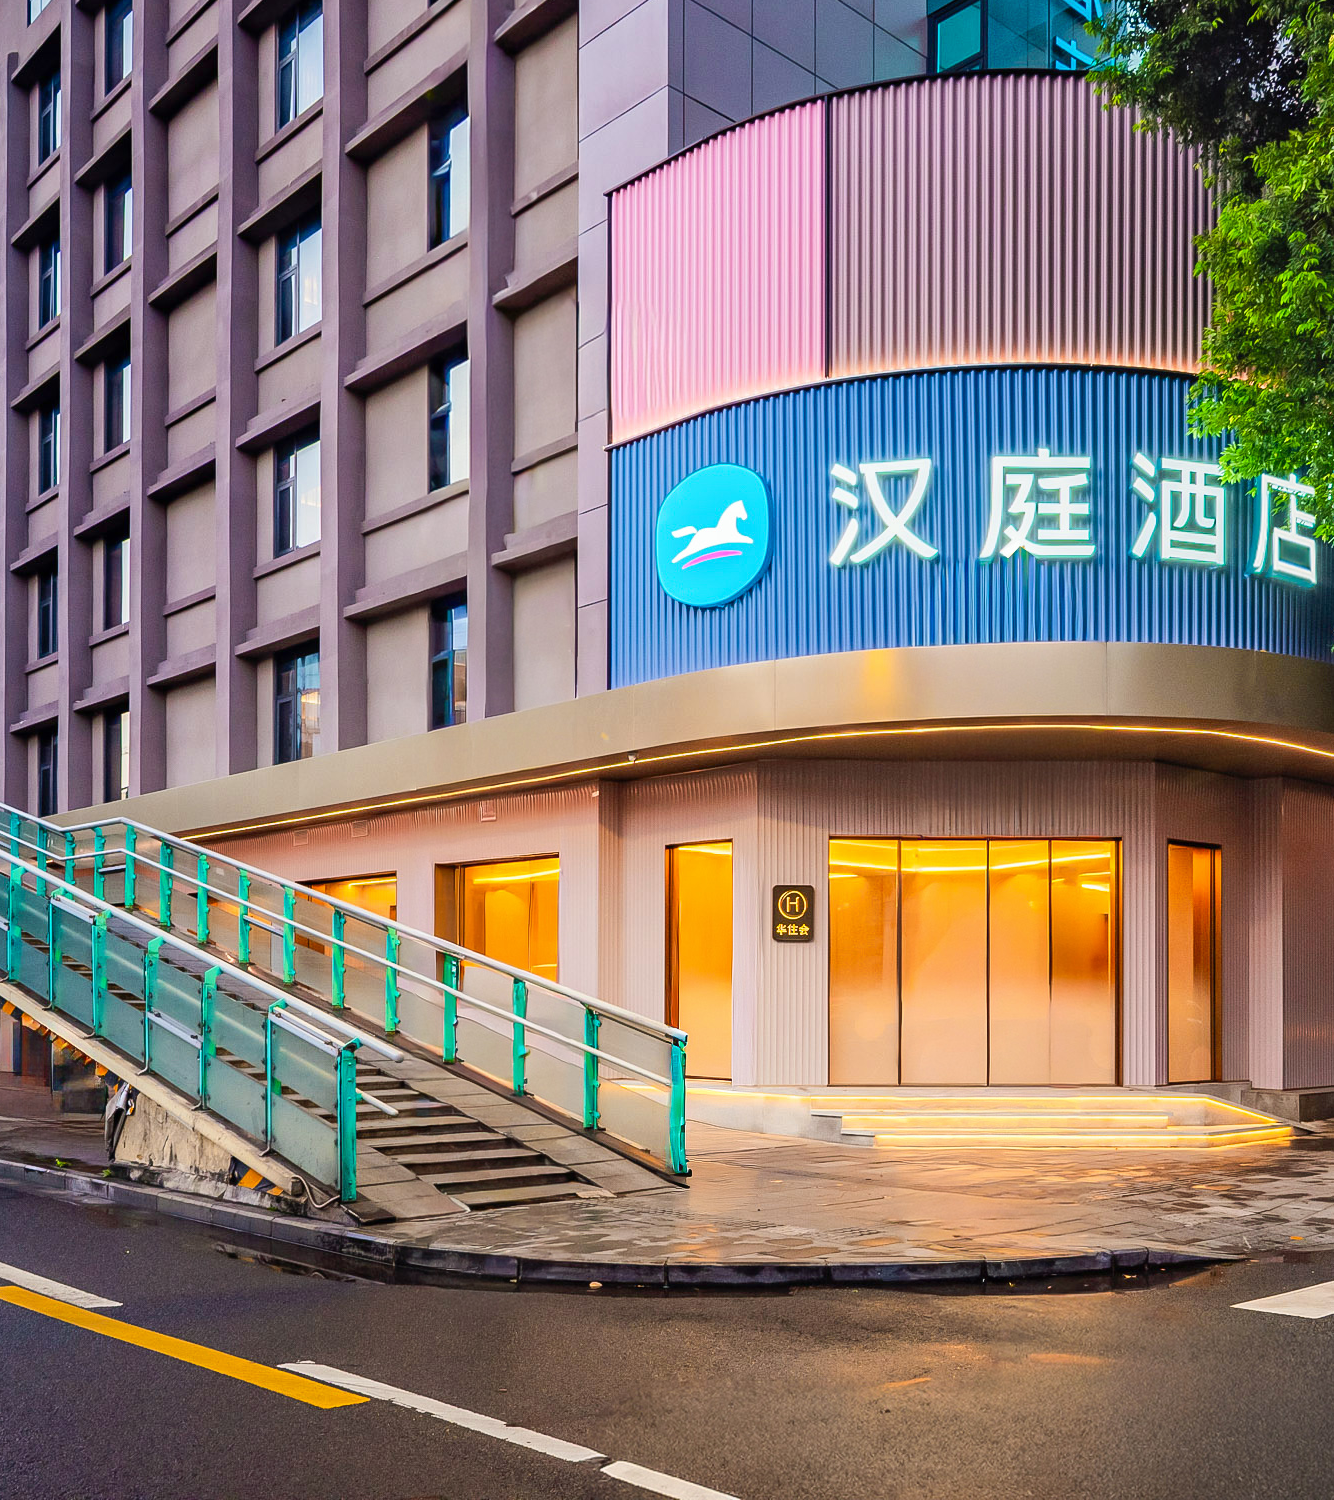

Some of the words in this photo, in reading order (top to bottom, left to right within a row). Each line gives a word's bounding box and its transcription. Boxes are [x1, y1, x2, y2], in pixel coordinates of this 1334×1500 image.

[829, 448, 1319, 586] 汉庭酒店
[776, 923, 810, 936] 华住会
